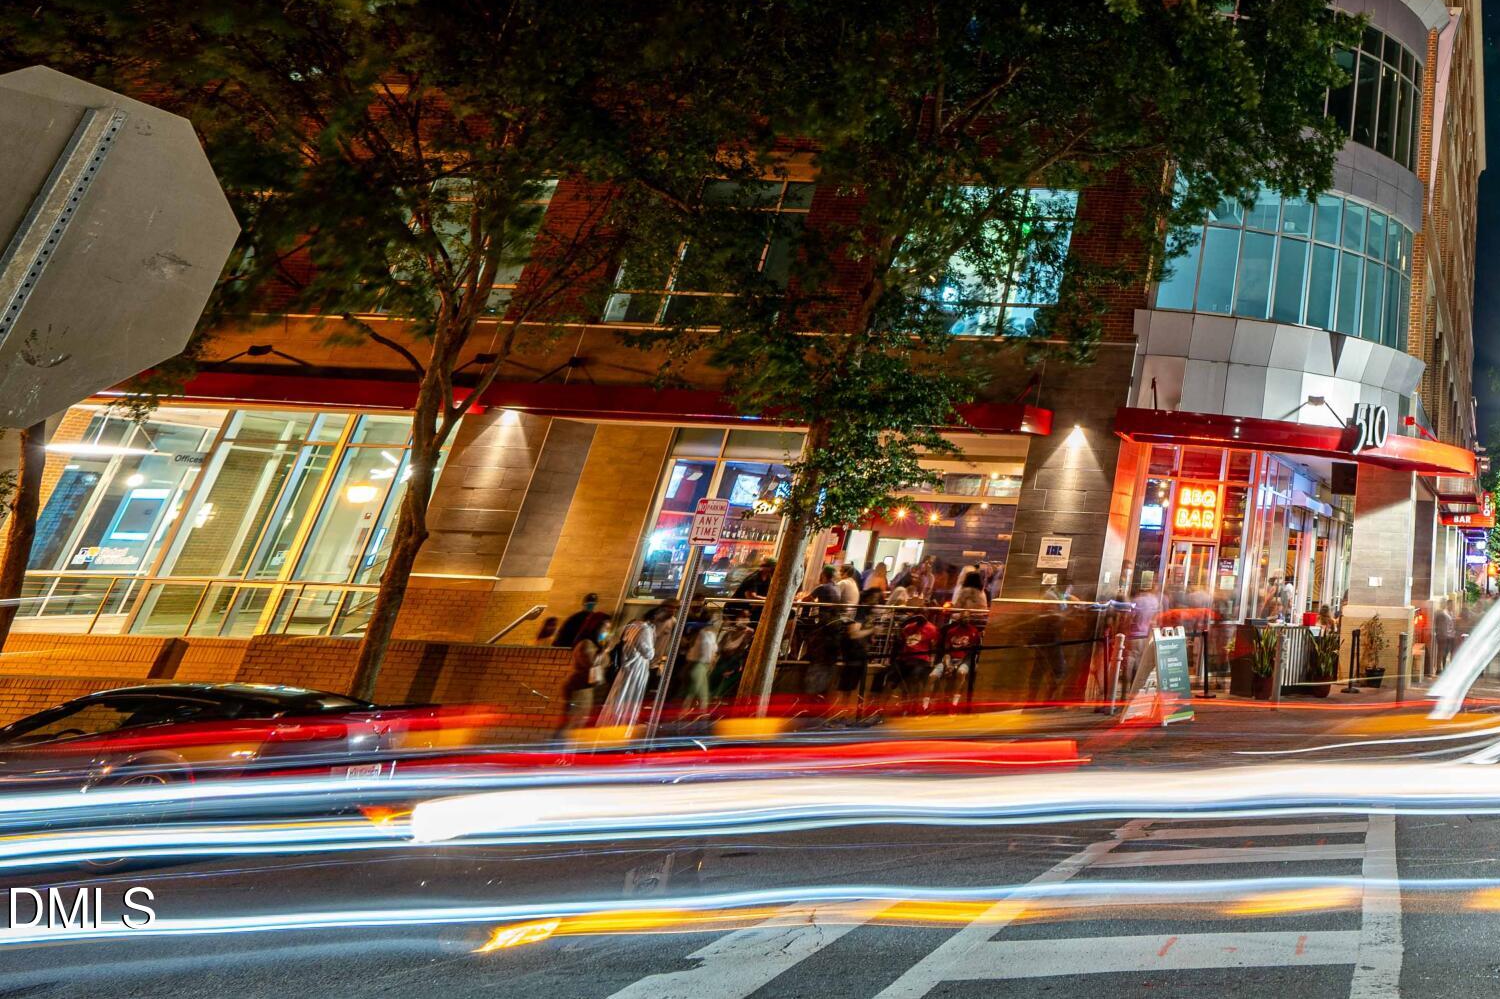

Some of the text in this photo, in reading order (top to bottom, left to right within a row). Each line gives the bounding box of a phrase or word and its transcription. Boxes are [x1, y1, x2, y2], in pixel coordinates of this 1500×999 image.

[1353, 403, 1389, 455] 510
[1180, 487, 1216, 507] BBQ
[699, 517, 719, 525] ANY
[1176, 508, 1214, 529] BAR
[696, 527, 718, 536] TIME
